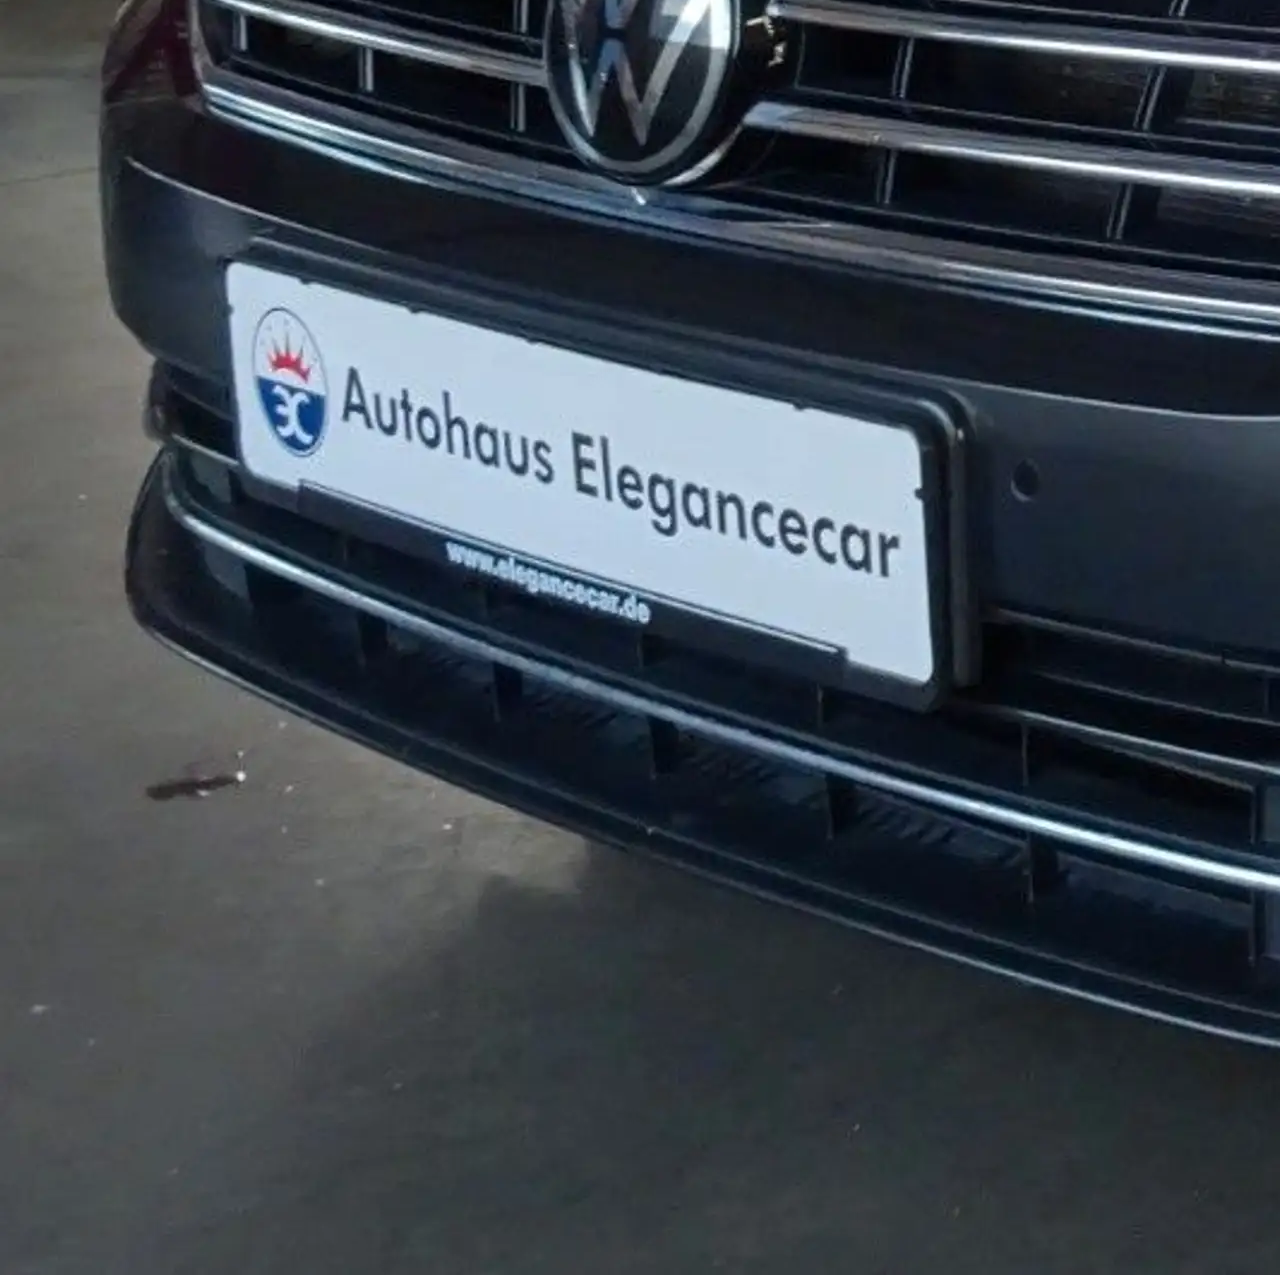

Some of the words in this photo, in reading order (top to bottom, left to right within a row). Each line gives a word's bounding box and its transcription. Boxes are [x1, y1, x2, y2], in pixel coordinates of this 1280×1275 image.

[342, 365, 555, 484] Autohaus
[571, 430, 900, 578] Elegancecar
[445, 540, 652, 624] www.elegancecar.de
